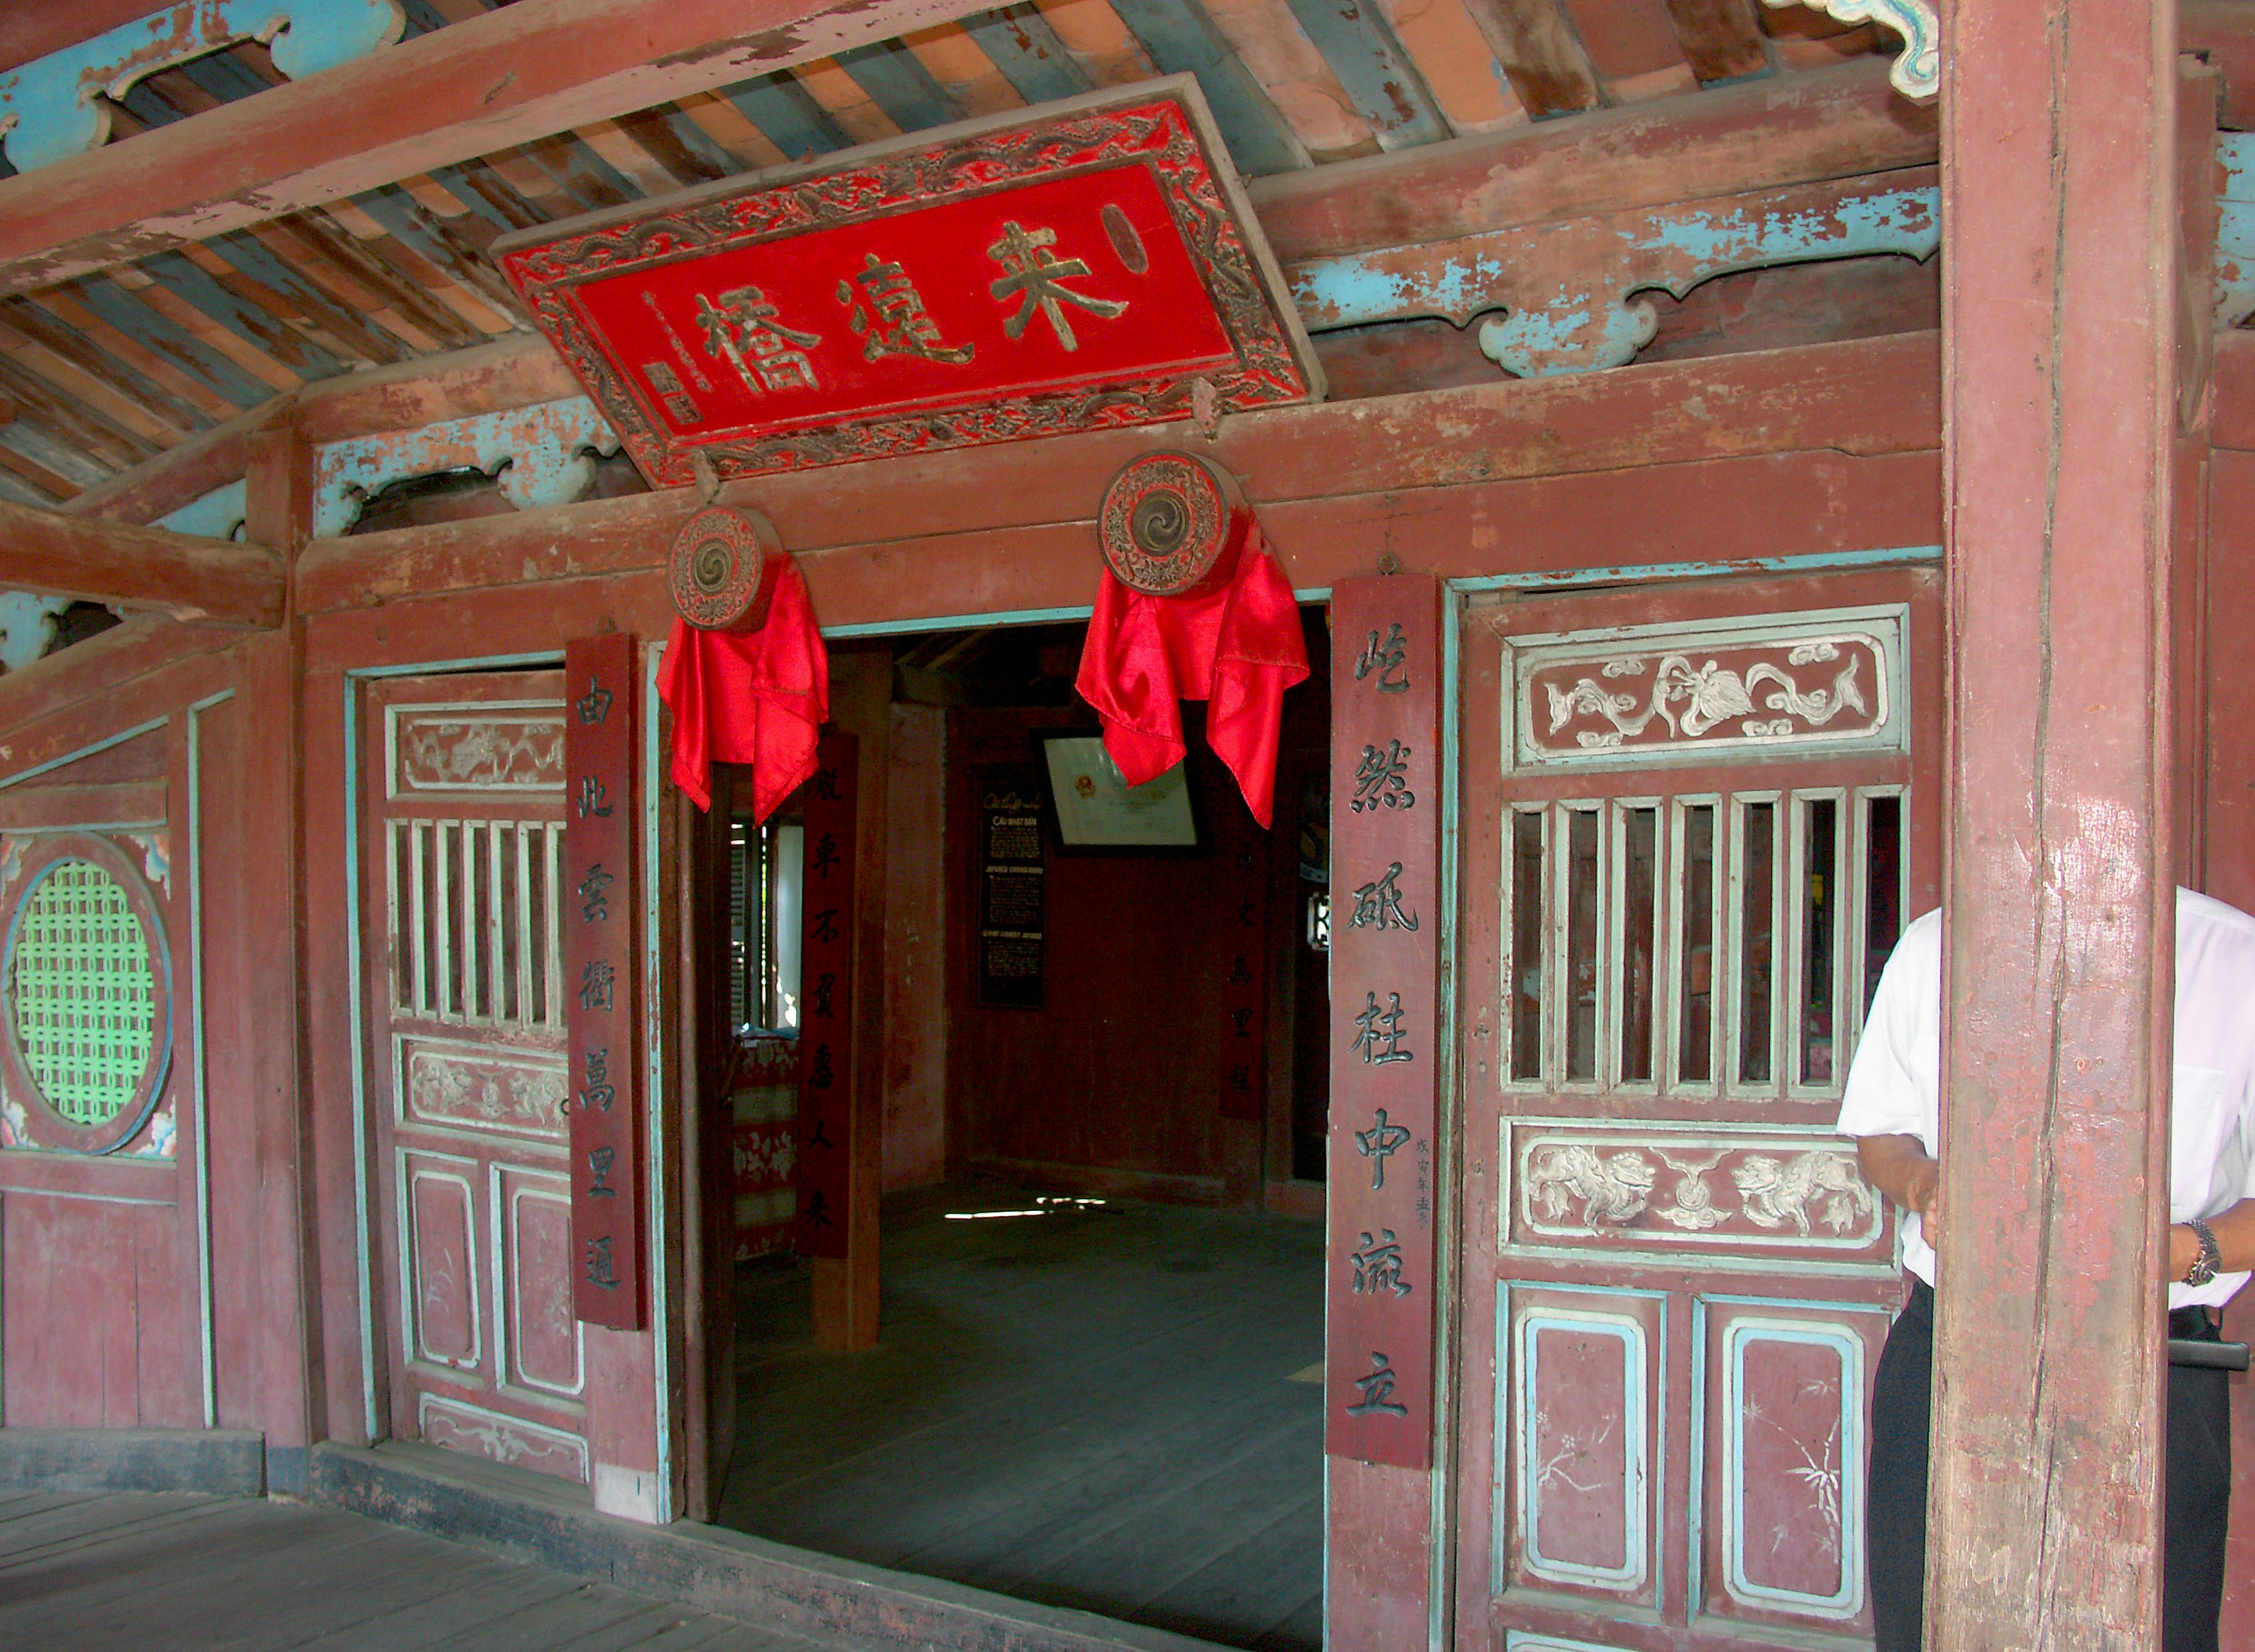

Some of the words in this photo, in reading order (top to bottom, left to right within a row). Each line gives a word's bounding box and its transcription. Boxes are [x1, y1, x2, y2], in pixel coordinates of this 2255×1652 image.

[577, 675, 621, 1291] 由此雲衢萬里通
[1344, 622, 1418, 1419] 屹然砥柱中流立
